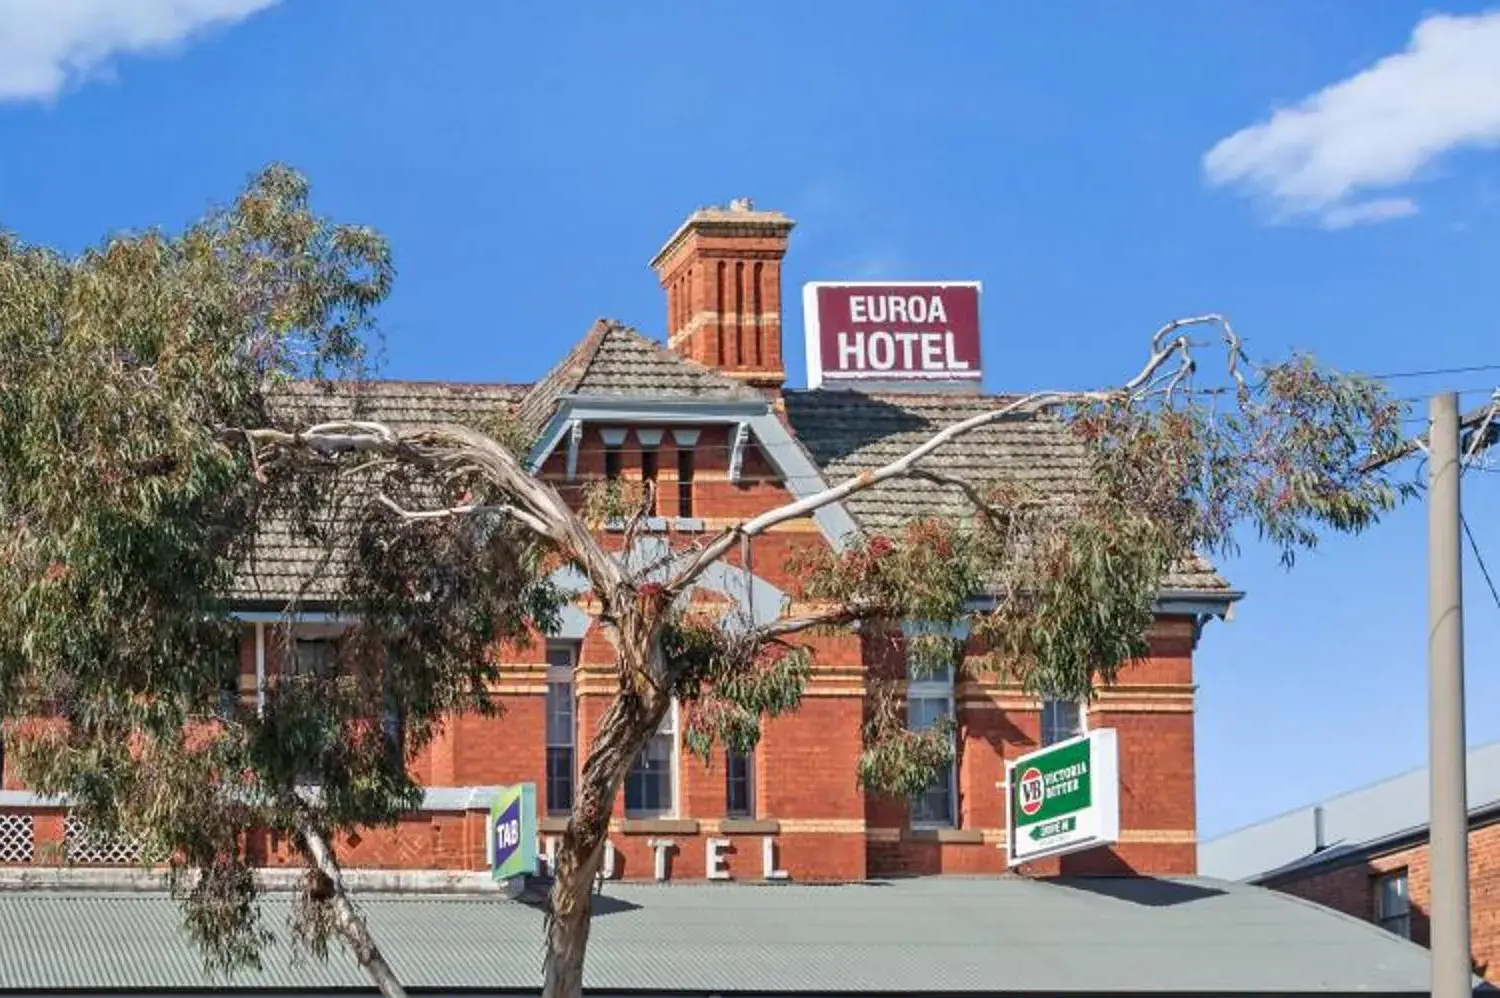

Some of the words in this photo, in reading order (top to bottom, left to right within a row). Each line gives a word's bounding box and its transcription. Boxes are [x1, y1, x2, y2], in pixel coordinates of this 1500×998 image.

[850, 295, 948, 323] EUROA
[837, 330, 969, 370] HOTEL
[1044, 761, 1088, 785] VICTORIA
[1022, 779, 1042, 803] VB
[497, 819, 519, 849] TAB
